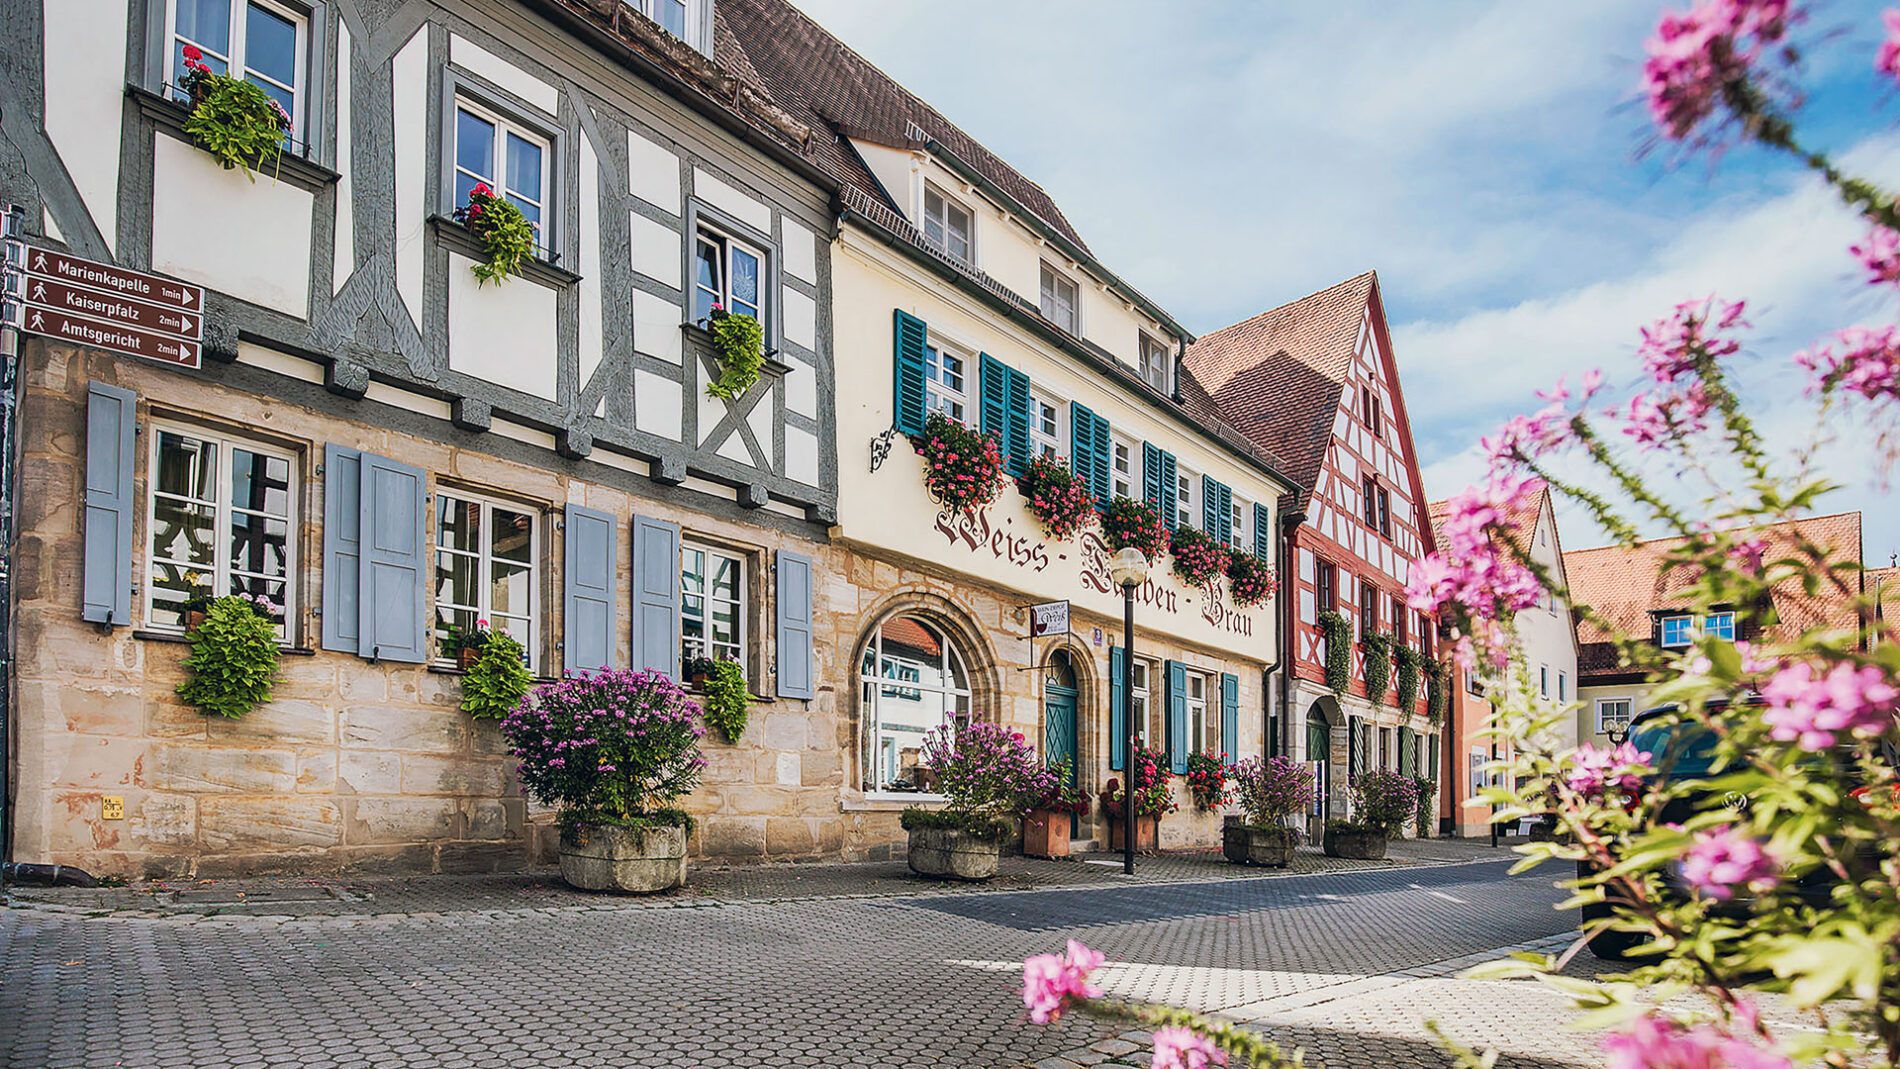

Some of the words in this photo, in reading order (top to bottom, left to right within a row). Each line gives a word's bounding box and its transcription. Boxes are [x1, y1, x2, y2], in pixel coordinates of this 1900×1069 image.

[58, 260, 151, 294] Marienkapelle
[161, 287, 181, 300] 1min
[66, 291, 140, 320] Kaiserpfalz
[159, 315, 180, 328] 2min
[61, 320, 141, 349] Amtsgericht
[157, 343, 178, 356] 2min
